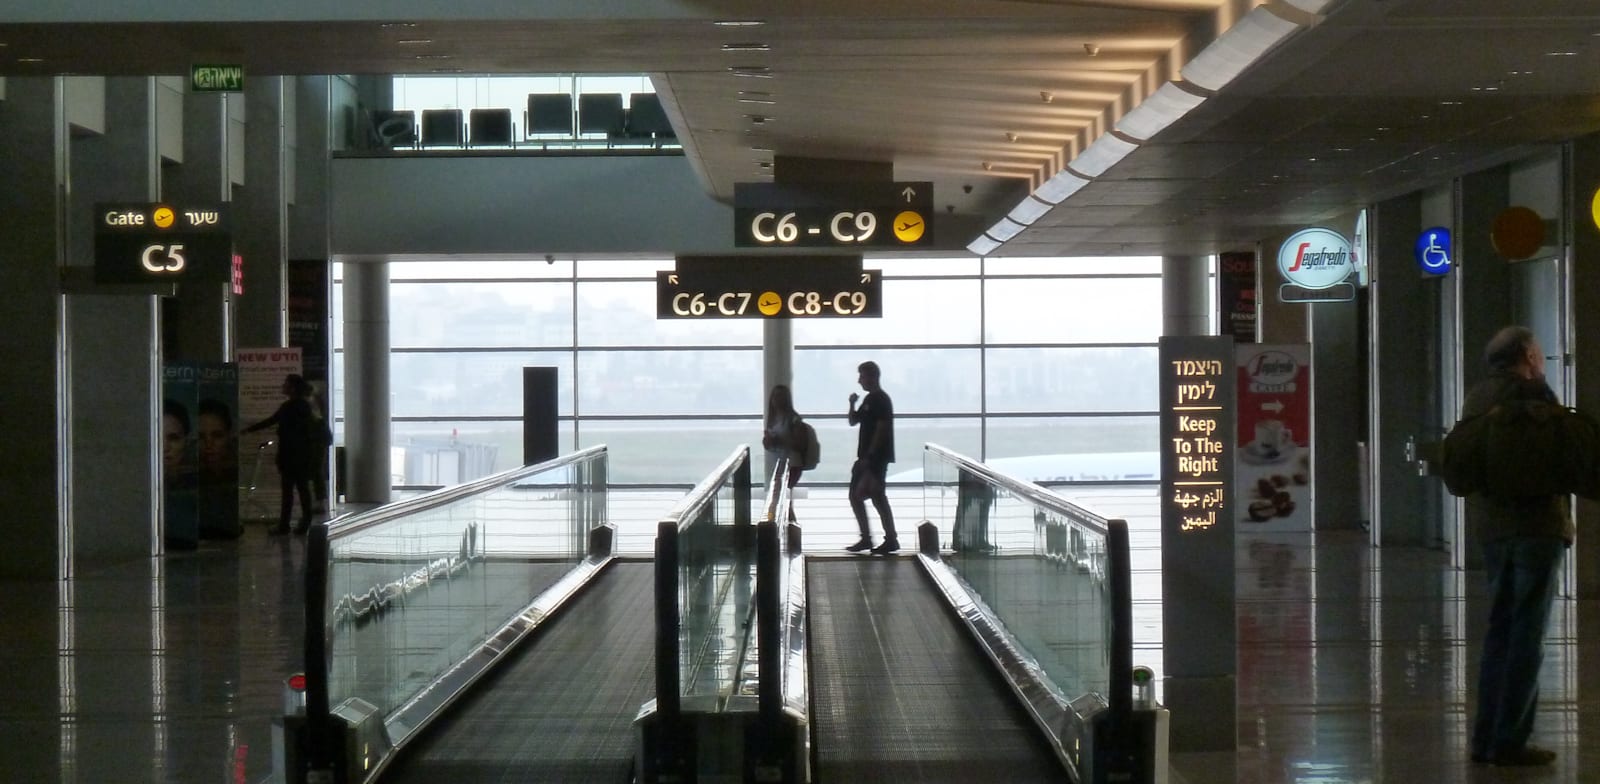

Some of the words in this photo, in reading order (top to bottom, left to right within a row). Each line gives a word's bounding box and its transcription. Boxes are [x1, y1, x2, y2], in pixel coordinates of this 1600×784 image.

[105, 211, 145, 226] Gate
[184, 212, 218, 226] שער
[752, 211, 798, 243] C6
[830, 211, 877, 242] C9
[141, 244, 185, 272] C5
[1288, 242, 1347, 272] Segafredo
[672, 292, 752, 316] C6-C7
[787, 291, 867, 316] C8-C9
[238, 352, 268, 363] NEW
[271, 352, 299, 363] חדש
[1171, 360, 1223, 376] היצמד
[1178, 380, 1216, 404] לימין
[1179, 416, 1217, 436] Keep
[1172, 438, 1192, 454] To
[1194, 437, 1223, 453] The
[1178, 456, 1219, 477] Right
[1173, 489, 1201, 508] جهة
[1202, 488, 1223, 509] إلزم
[1181, 511, 1216, 531] اليمين
